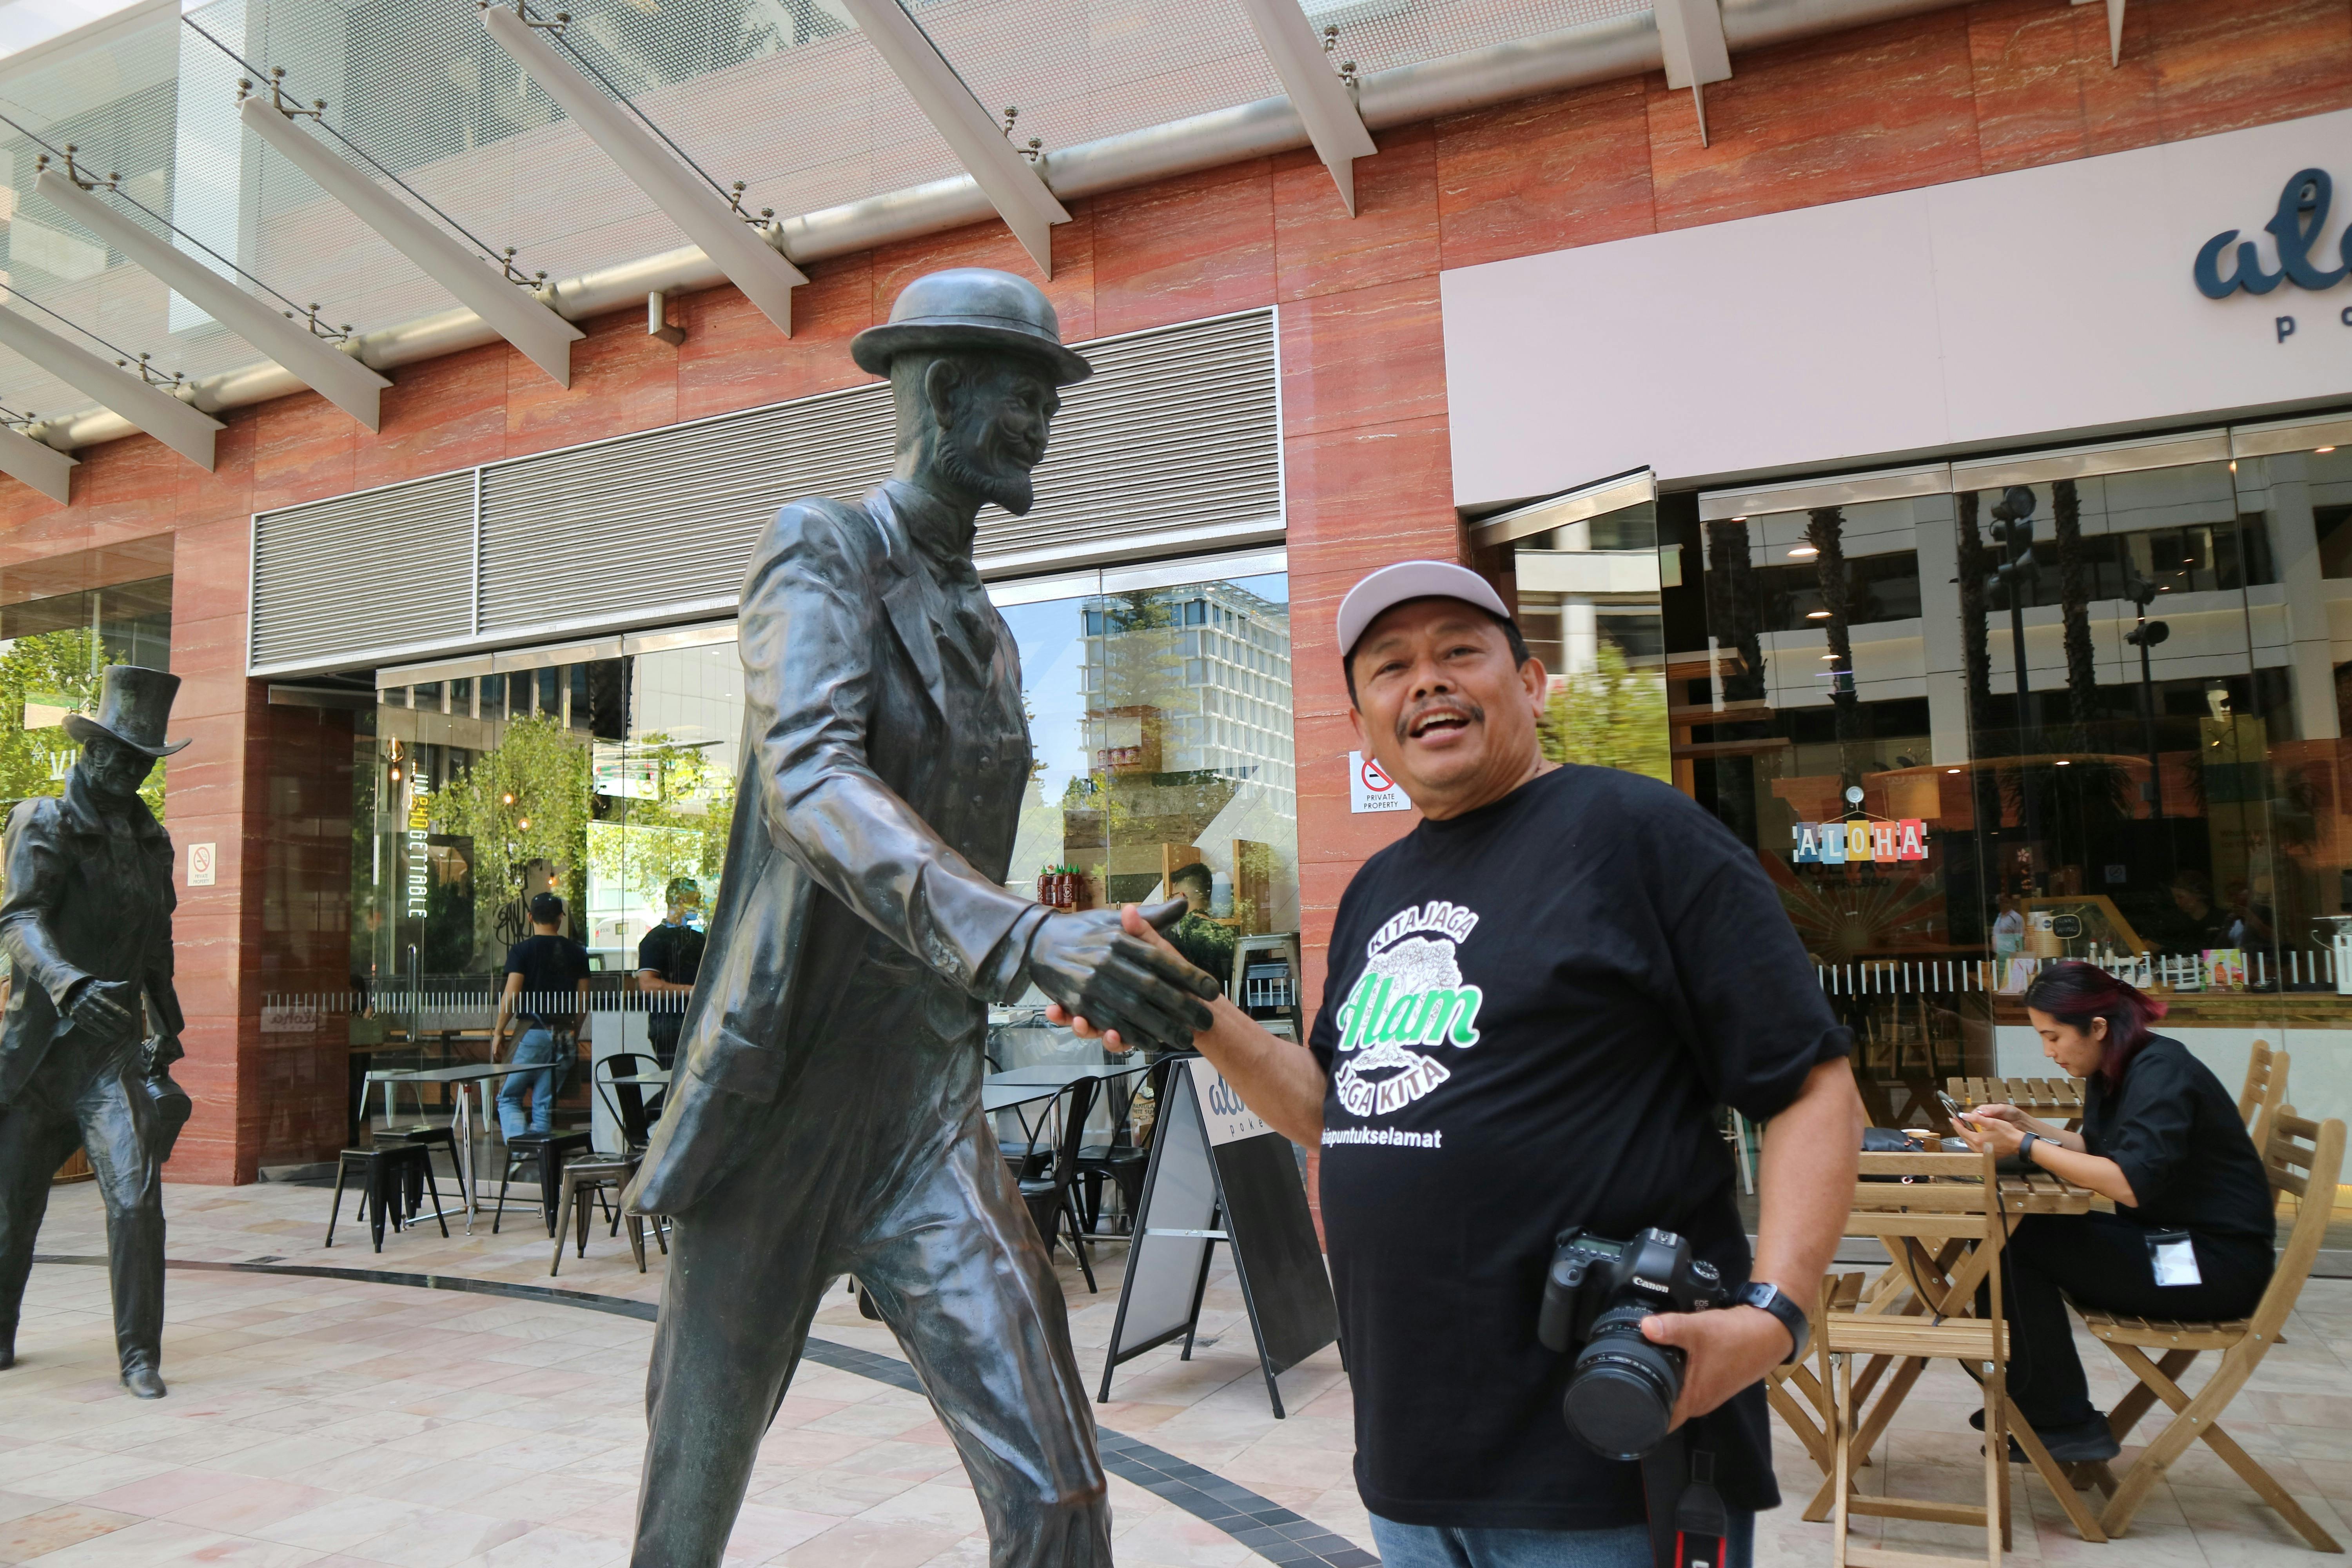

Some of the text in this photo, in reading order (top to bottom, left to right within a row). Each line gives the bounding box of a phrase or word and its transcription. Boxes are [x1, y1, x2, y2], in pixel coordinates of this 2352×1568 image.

[1799, 826, 1922, 857] ALOHA
[1369, 902, 1478, 956] KITA JAGA
[1338, 973, 1482, 1047] Alam
[1377, 1056, 1449, 1114] KITA
[1229, 1118, 1263, 1136] poke
[1632, 1276, 1669, 1293] Canon
